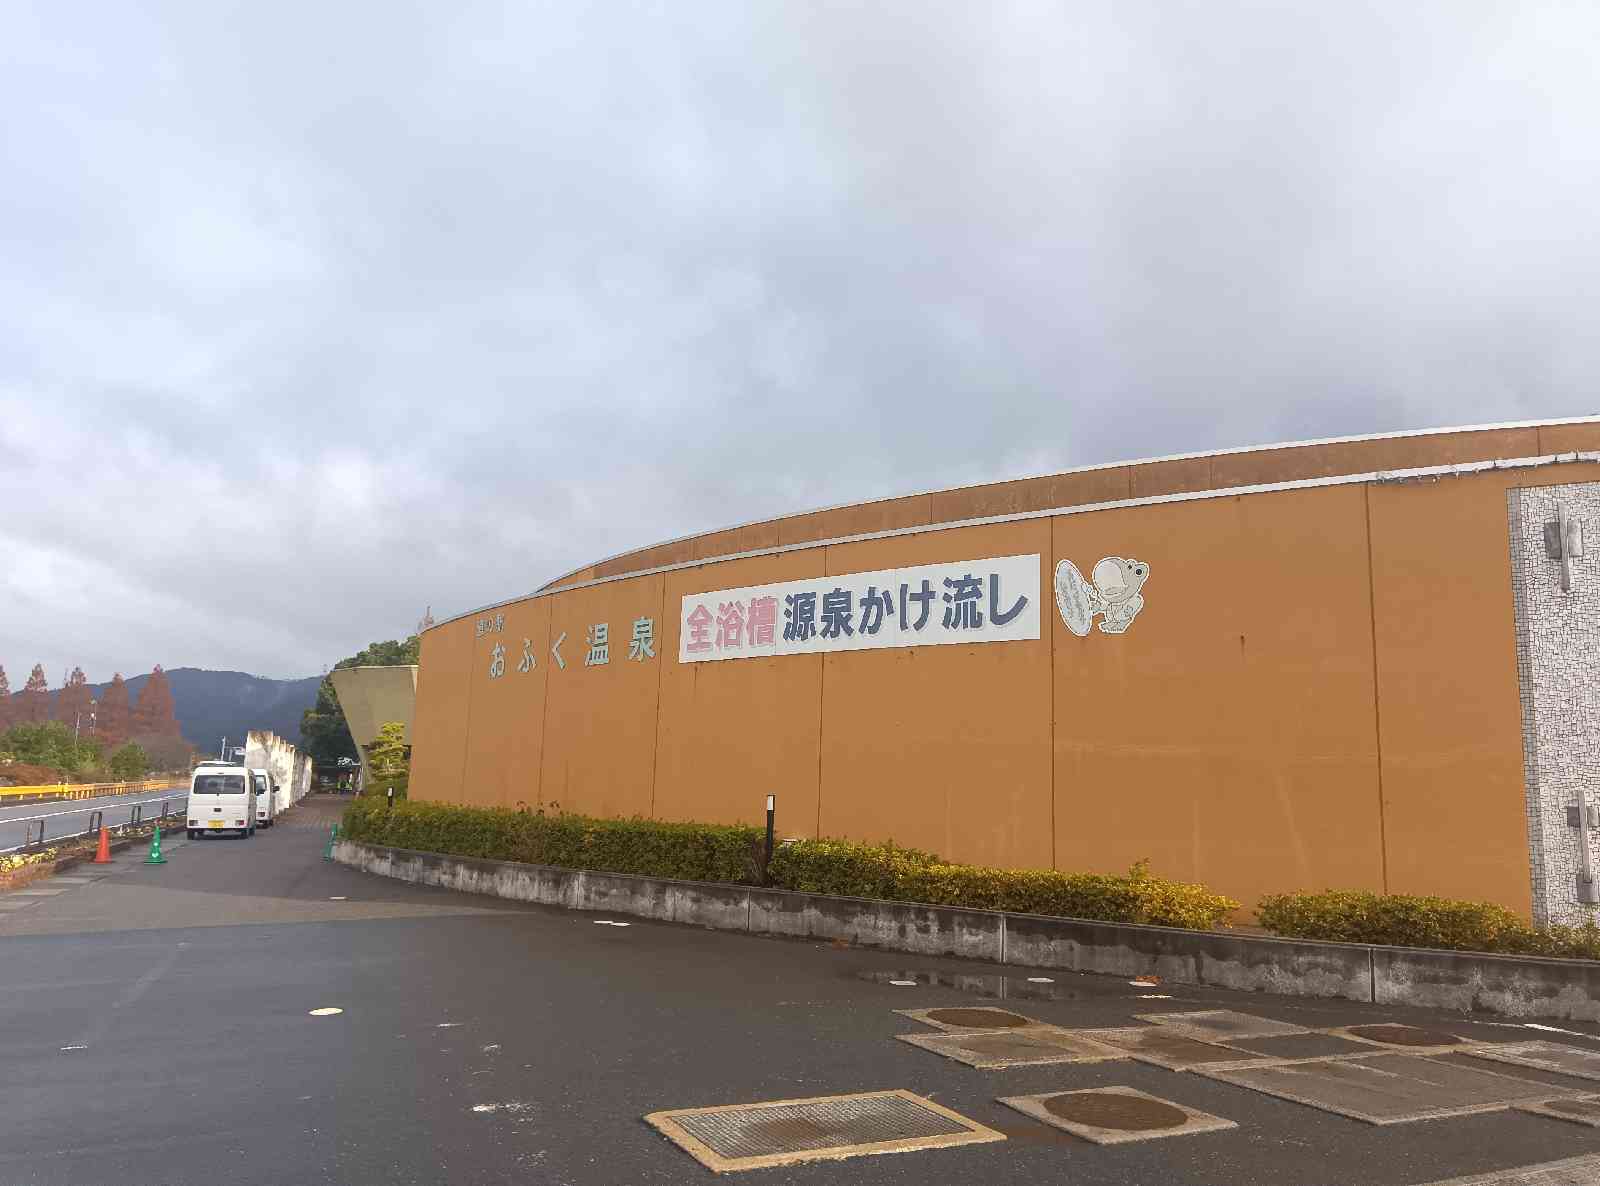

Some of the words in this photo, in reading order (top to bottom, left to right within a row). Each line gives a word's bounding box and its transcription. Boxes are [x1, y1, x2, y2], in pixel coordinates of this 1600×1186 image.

[489, 616, 656, 680] おふく温泉
